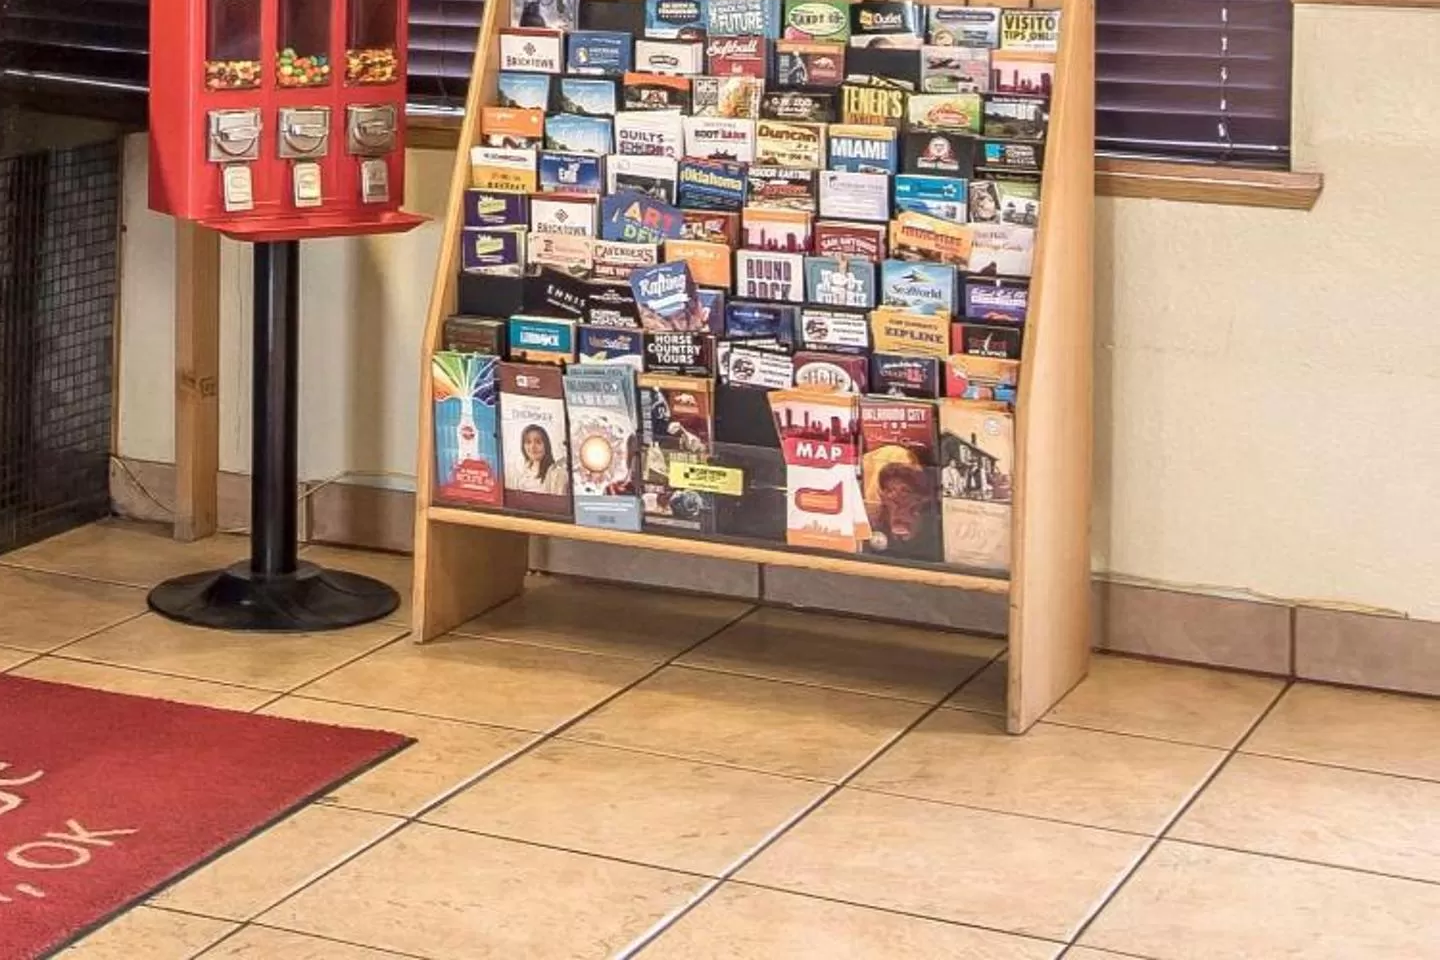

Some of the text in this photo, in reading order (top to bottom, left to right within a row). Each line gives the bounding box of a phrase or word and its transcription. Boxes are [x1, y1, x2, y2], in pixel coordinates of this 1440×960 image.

[718, 12, 763, 33] FUTURE
[1003, 15, 1057, 30] VISITO
[1004, 30, 1059, 42] TIPS ONLI
[758, 125, 817, 142] Duncan
[831, 138, 887, 159] MIAMI
[594, 244, 654, 262] CAVENDER'S
[746, 258, 792, 281] ROUND
[746, 280, 792, 301] ROCK
[892, 284, 942, 299] SeaWorld
[654, 334, 693, 346] HORSE
[884, 326, 945, 345] ZIPLINE
[647, 343, 702, 356] COUNTRY
[657, 354, 695, 365] TOURS
[907, 409, 926, 422] CITY
[796, 442, 844, 461] MAP
[5, 818, 139, 870] OK
